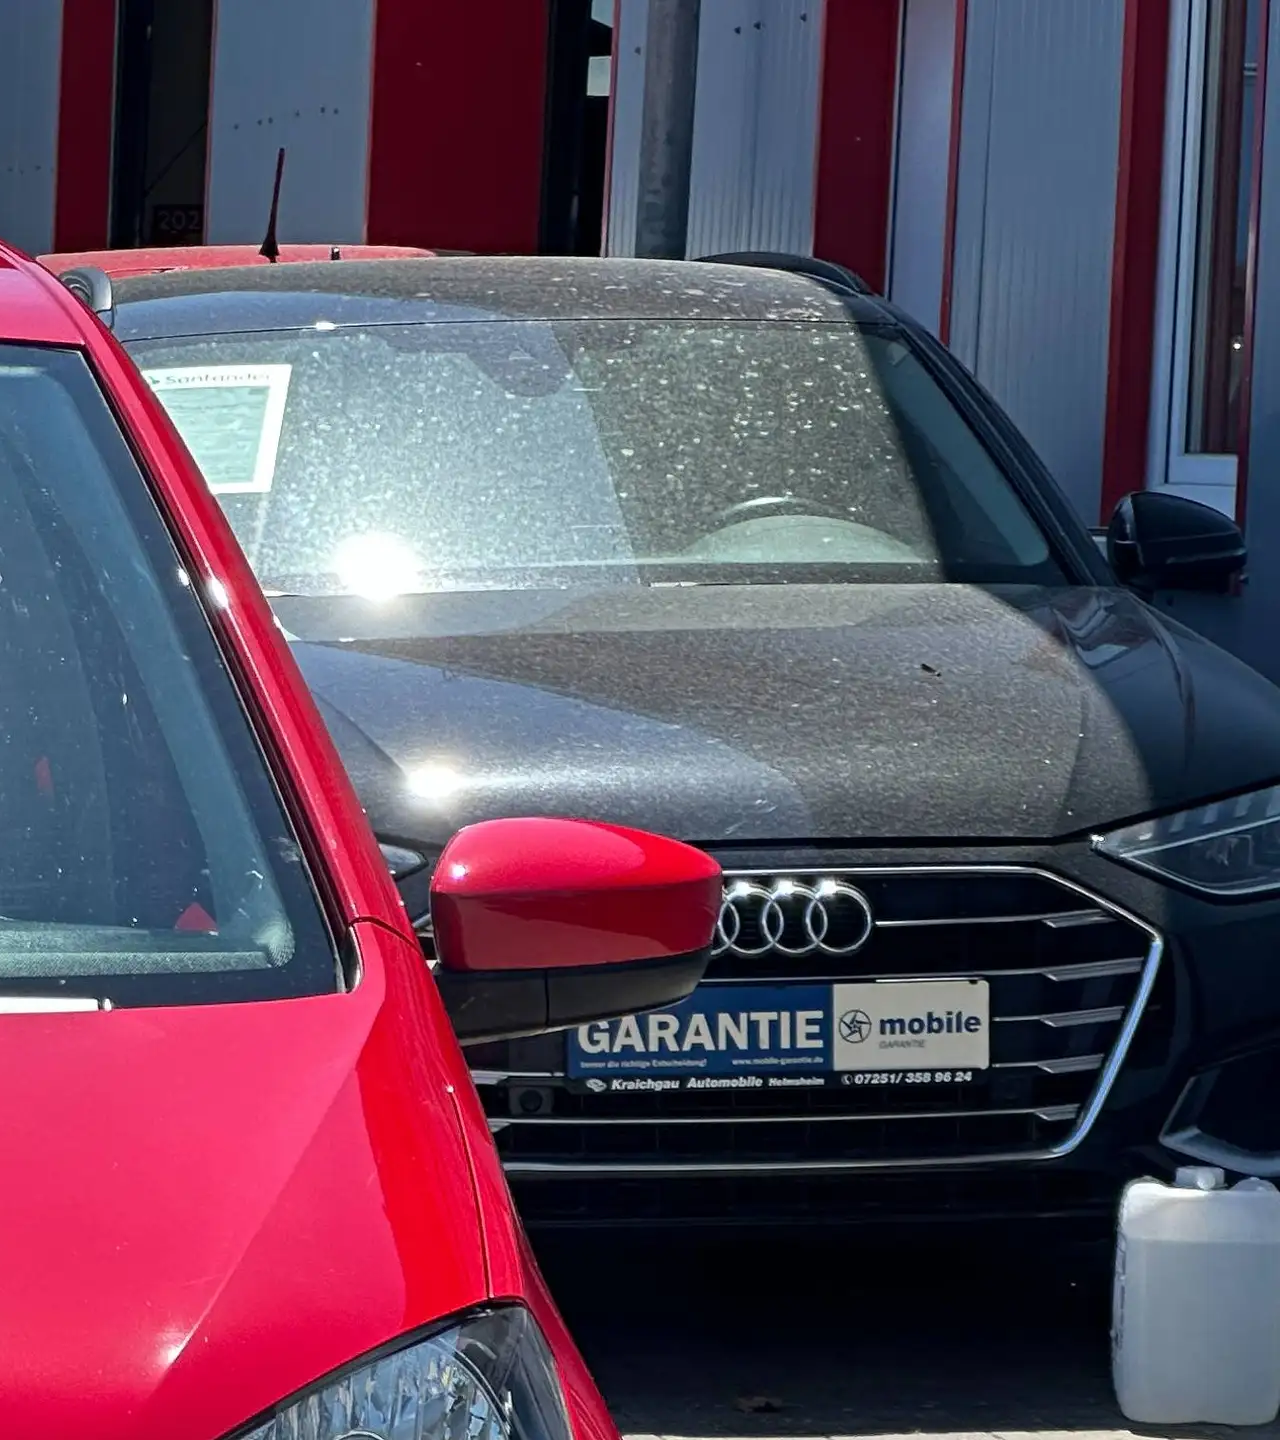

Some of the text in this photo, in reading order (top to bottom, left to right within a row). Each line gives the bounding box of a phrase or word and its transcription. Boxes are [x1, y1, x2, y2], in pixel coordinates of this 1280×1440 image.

[879, 1011, 981, 1035] mobile
[578, 1011, 824, 1053] GARANTIE
[879, 1040, 926, 1049] GARANTIE
[611, 1078, 680, 1091] Kraichgau
[686, 1076, 763, 1088] Automobile
[854, 1070, 973, 1084] 07251/ 358 96 24
